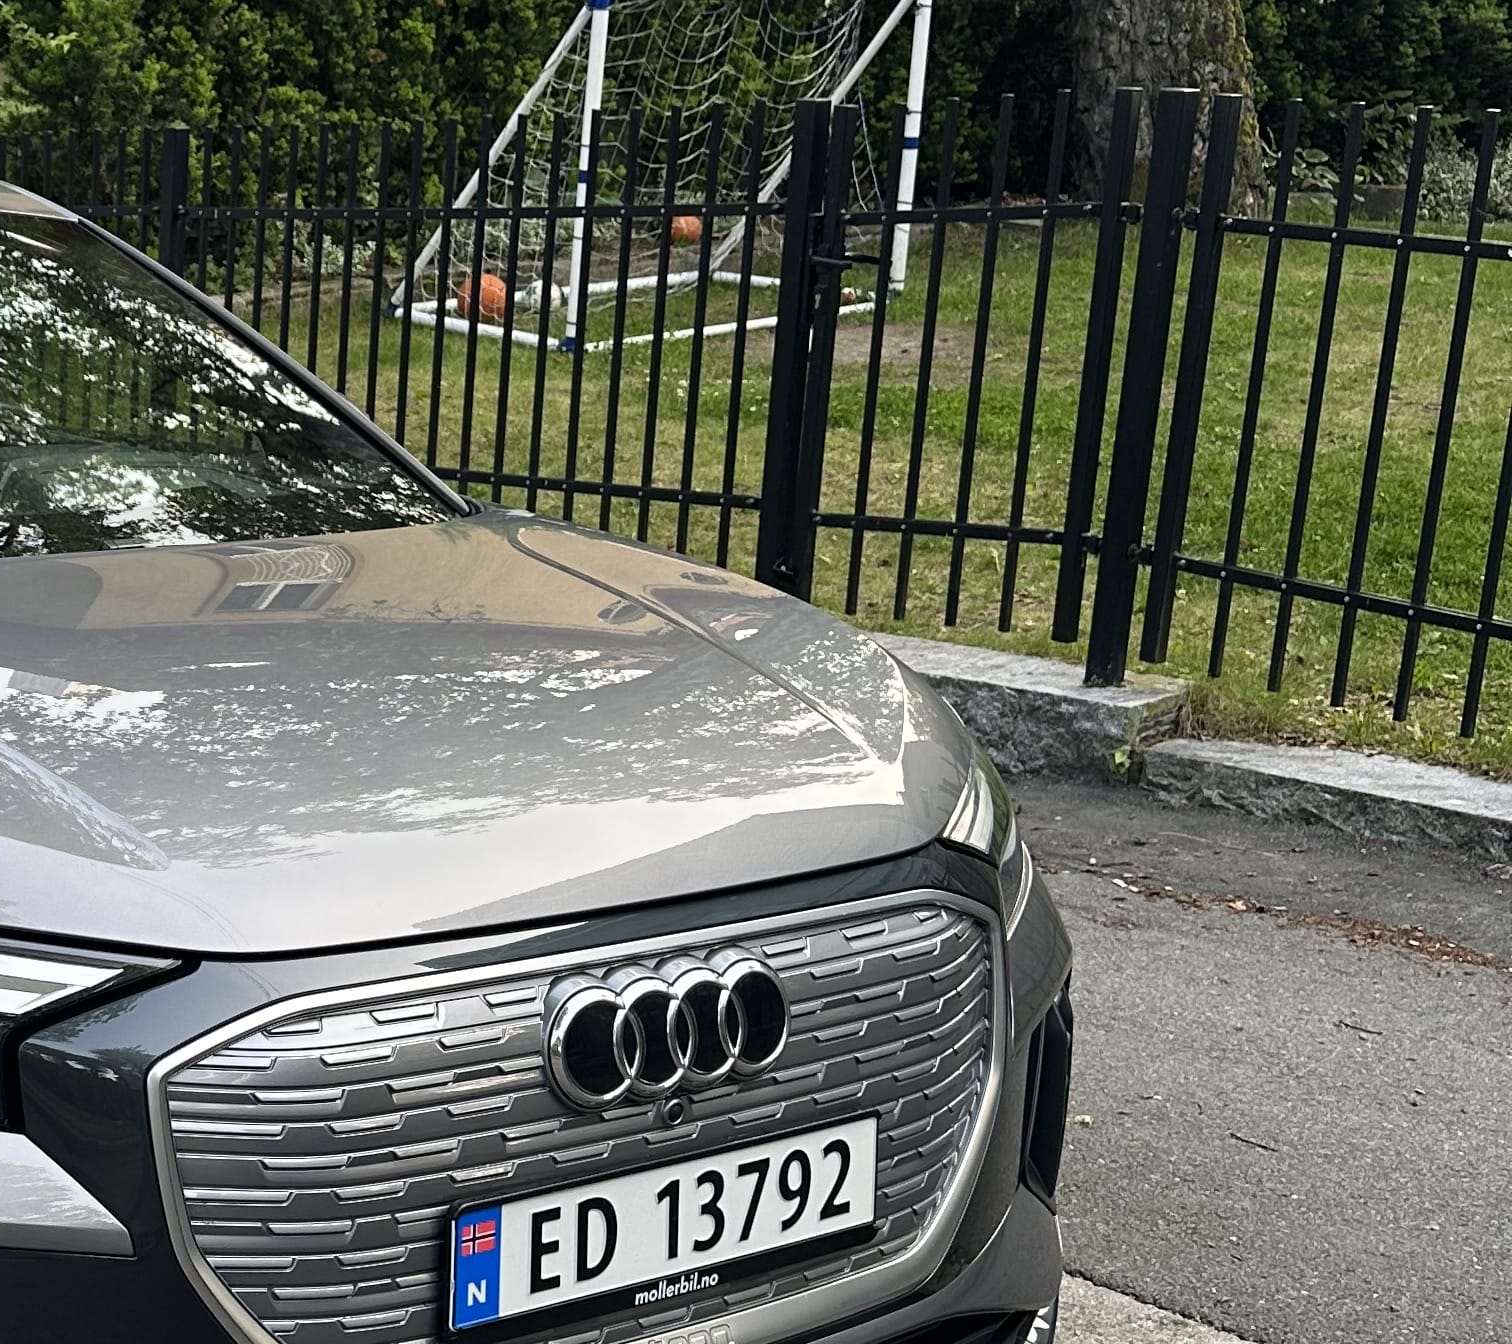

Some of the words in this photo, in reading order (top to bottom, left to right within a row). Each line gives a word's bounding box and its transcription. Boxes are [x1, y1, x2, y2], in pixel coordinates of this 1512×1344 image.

[529, 1194, 619, 1296] ED
[656, 1139, 851, 1260] 13792
[466, 1278, 487, 1306] N
[634, 1271, 719, 1305] mollerbil.no
